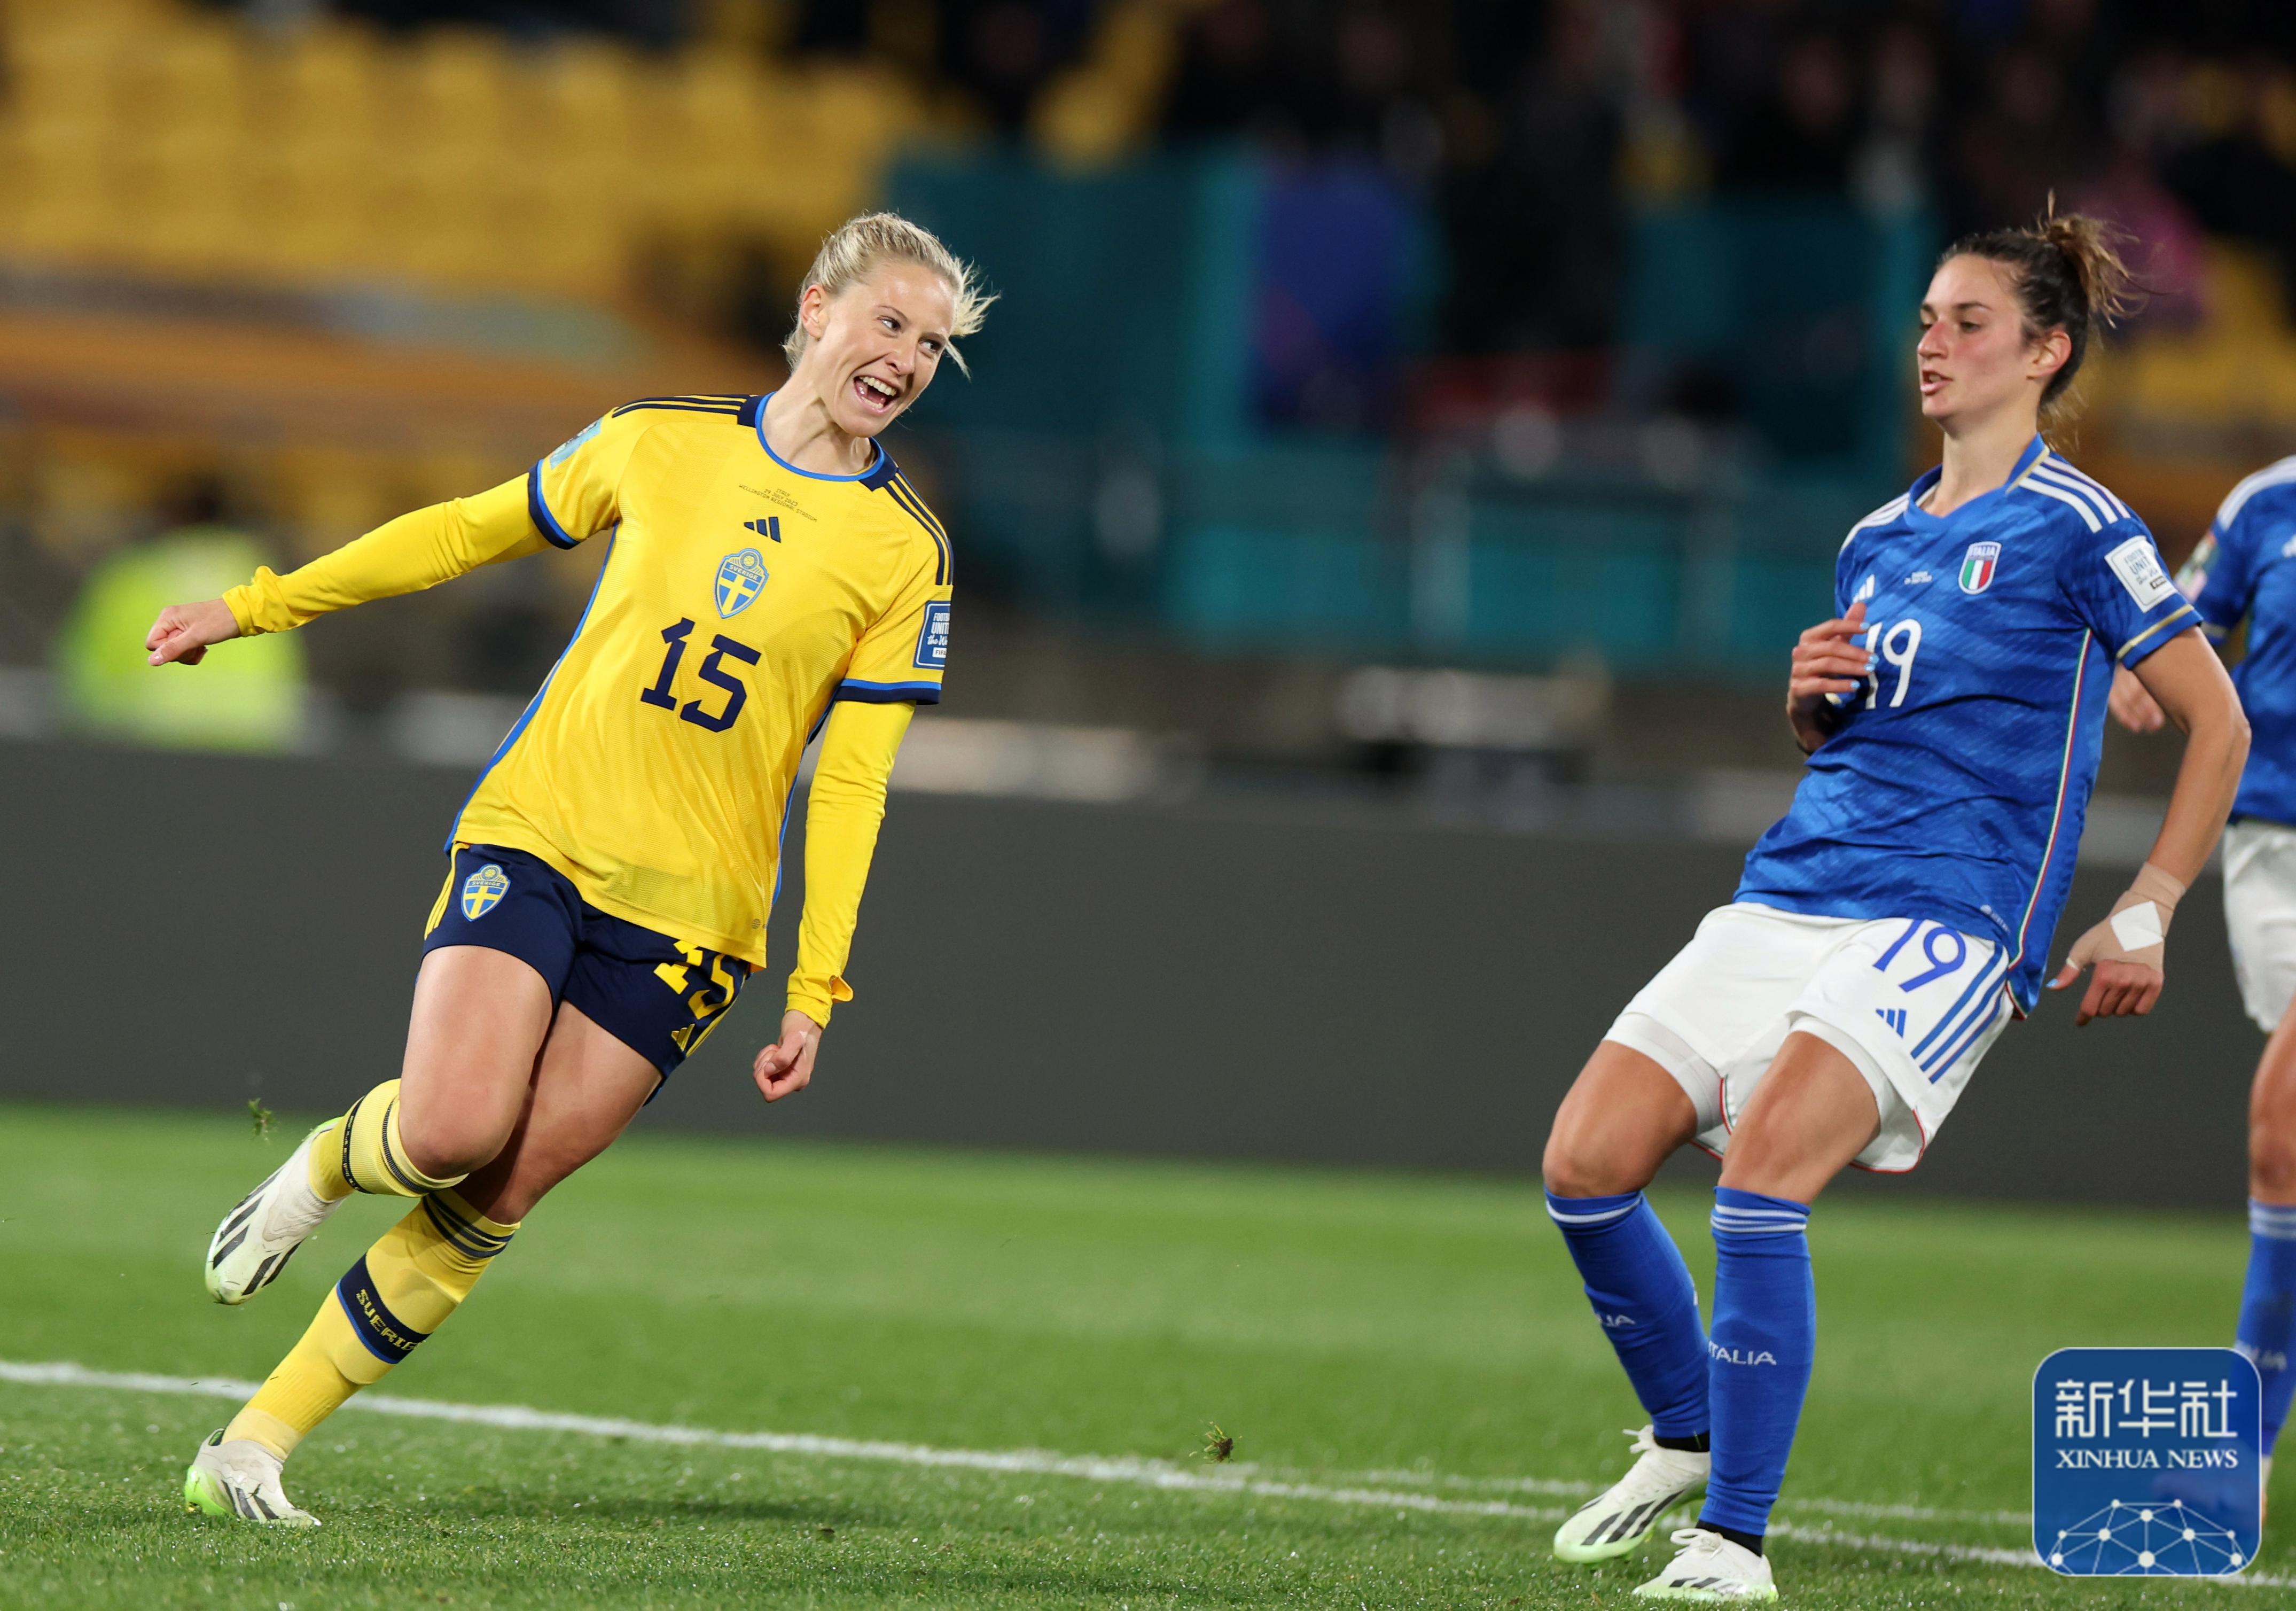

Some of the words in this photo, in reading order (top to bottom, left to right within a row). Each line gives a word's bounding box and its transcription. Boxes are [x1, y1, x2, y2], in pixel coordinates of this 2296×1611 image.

[739, 484, 770, 500] WELLINGTON
[771, 497, 795, 511] REGIONAL
[795, 509, 818, 523] STADIUM
[772, 492, 784, 500] JULY
[785, 498, 799, 507] 2023
[776, 488, 791, 497] ITALY
[729, 565, 759, 580] SVERIGE
[641, 617, 762, 733] 15
[1865, 618, 1922, 710] 19
[653, 940, 735, 1019] 15
[1872, 919, 1966, 993] 19
